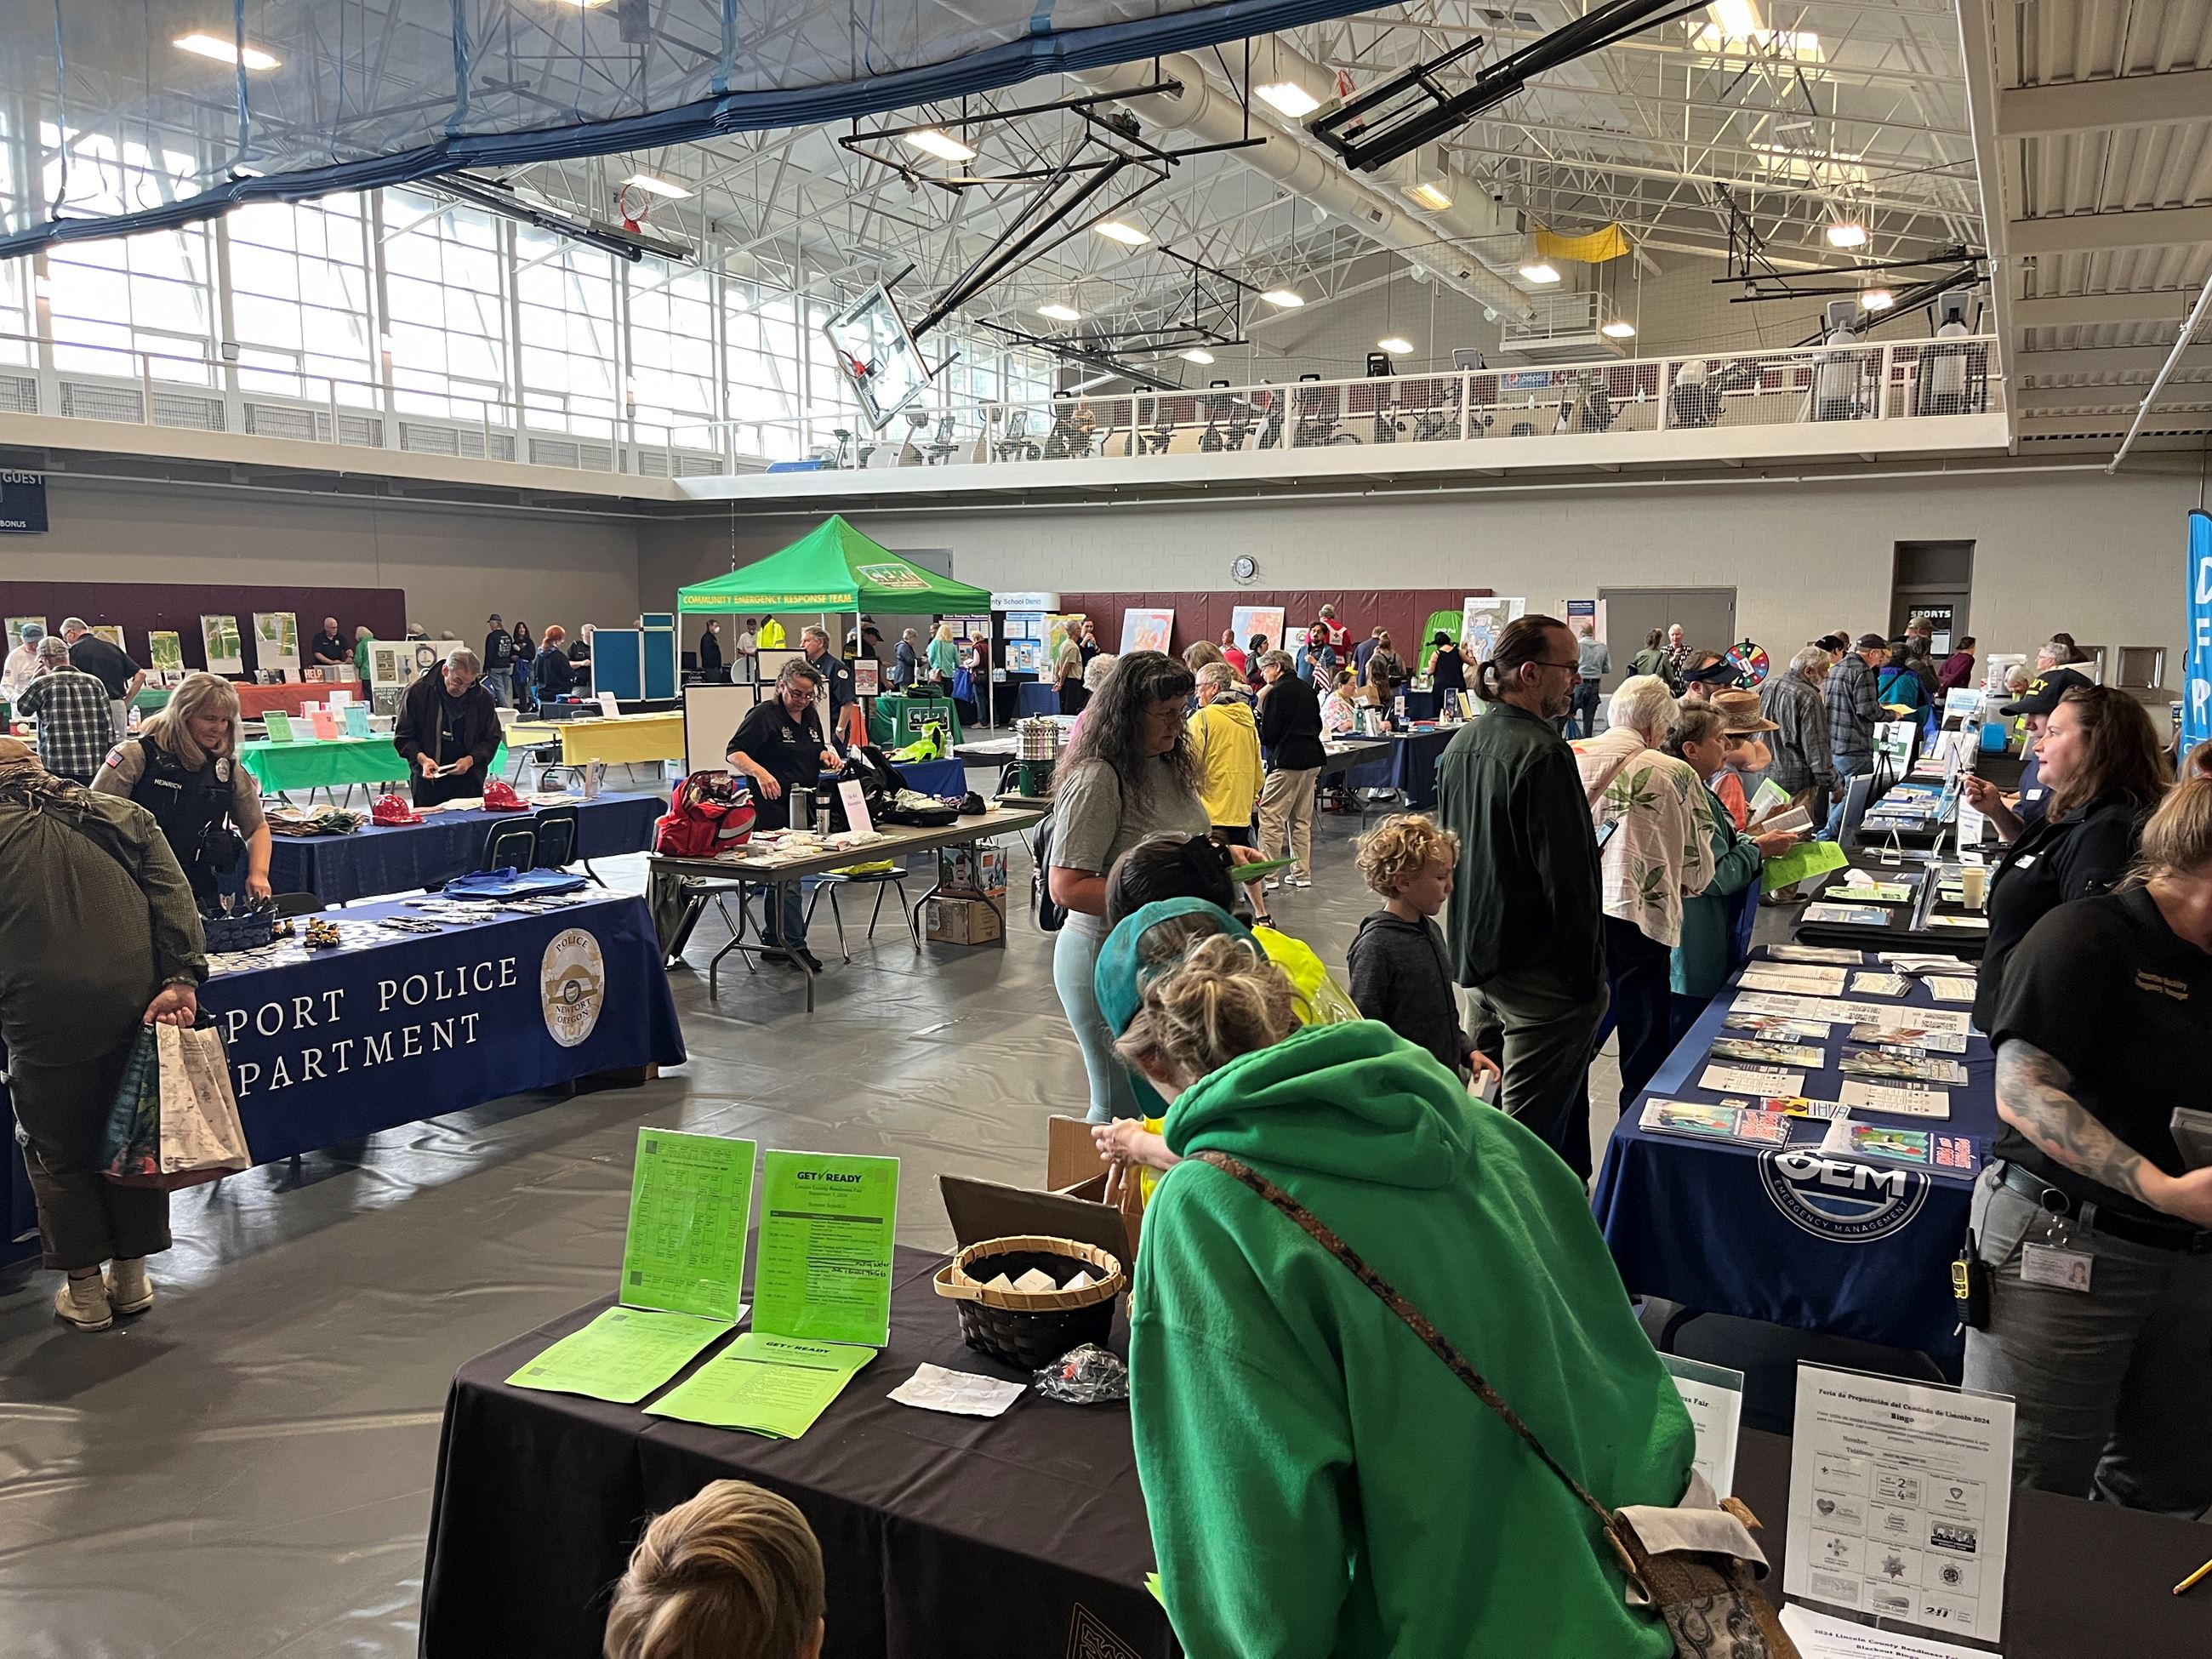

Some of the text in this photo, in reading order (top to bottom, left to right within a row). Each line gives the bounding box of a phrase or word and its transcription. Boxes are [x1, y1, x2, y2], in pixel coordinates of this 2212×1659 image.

[3, 472, 42, 484] GUEST
[683, 594, 852, 604] COMMUNITY EMERGENCY RESPONSE TEAM
[1911, 610, 1951, 619] SPORTS
[304, 669, 322, 679] HELP
[2029, 678, 2049, 691] VY
[154, 778, 182, 790] HEINRICH
[556, 936, 589, 952] POLICE
[225, 956, 518, 1045] PORT POLICE
[556, 998, 591, 1014] NEWPORT
[557, 1009, 589, 1024] OREGON
[237, 1013, 480, 1097] PARTMENT
[797, 1172, 862, 1183] GET READY
[1775, 1154, 1907, 1197] OEM
[1774, 1180, 1910, 1233] EMERGENCY MANAGEMENT
[794, 1344, 831, 1354] READY
[1694, 1398, 1709, 1407] Fair
[1819, 1388, 1836, 1397] Feria
[1946, 1411, 1972, 1422] Lincoln
[1974, 1417, 1990, 1425] 2024
[1890, 1413, 1914, 1423] Bingo
[1898, 1478, 1906, 1488] 2
[1897, 1490, 1905, 1501] 4
[1835, 1633, 1866, 1643] Lincoln
[1868, 1639, 1899, 1650] County
[1901, 1645, 1943, 1658] Readiness
[1856, 1645, 1919, 1659] Blackout Bingo
